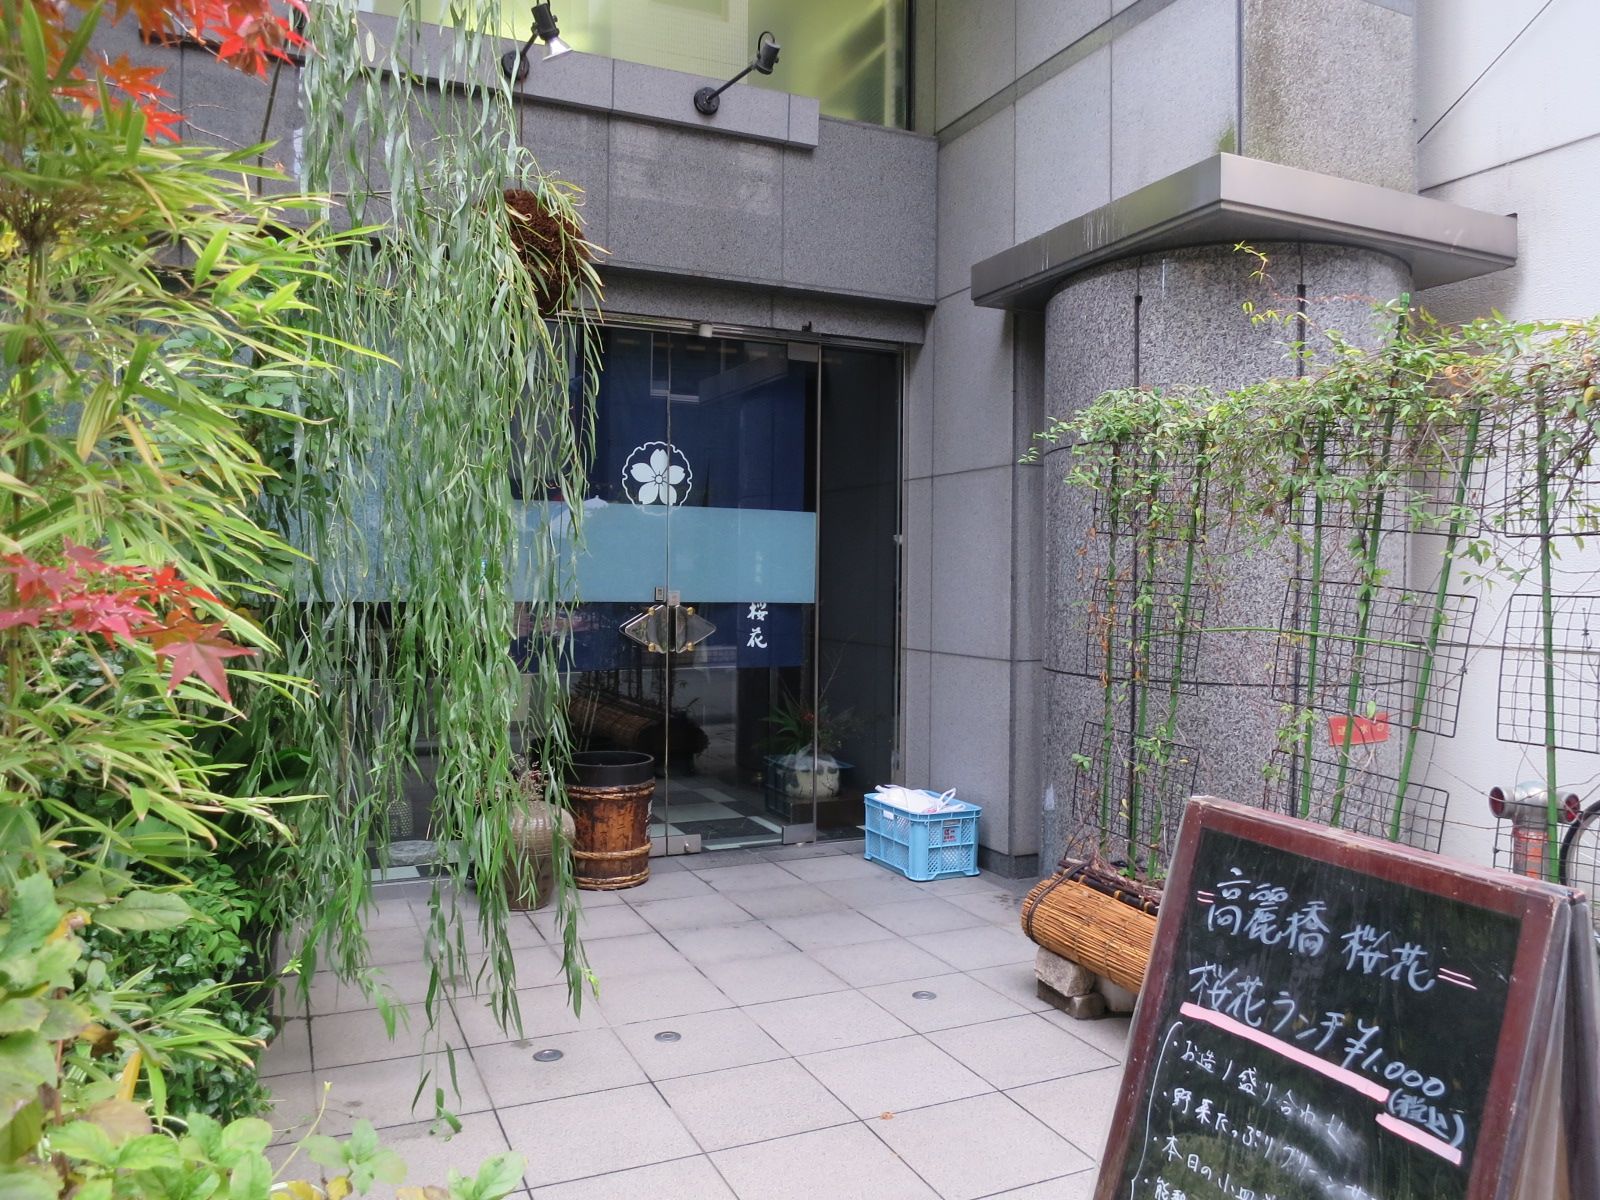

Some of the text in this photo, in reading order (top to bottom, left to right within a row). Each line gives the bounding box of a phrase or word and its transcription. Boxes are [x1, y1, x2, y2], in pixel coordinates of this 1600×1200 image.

[746, 602, 769, 649] 桜花
[1207, 866, 1436, 992] 高麗橋 桜花
[1161, 1135, 1277, 1200] 本日の小皿
